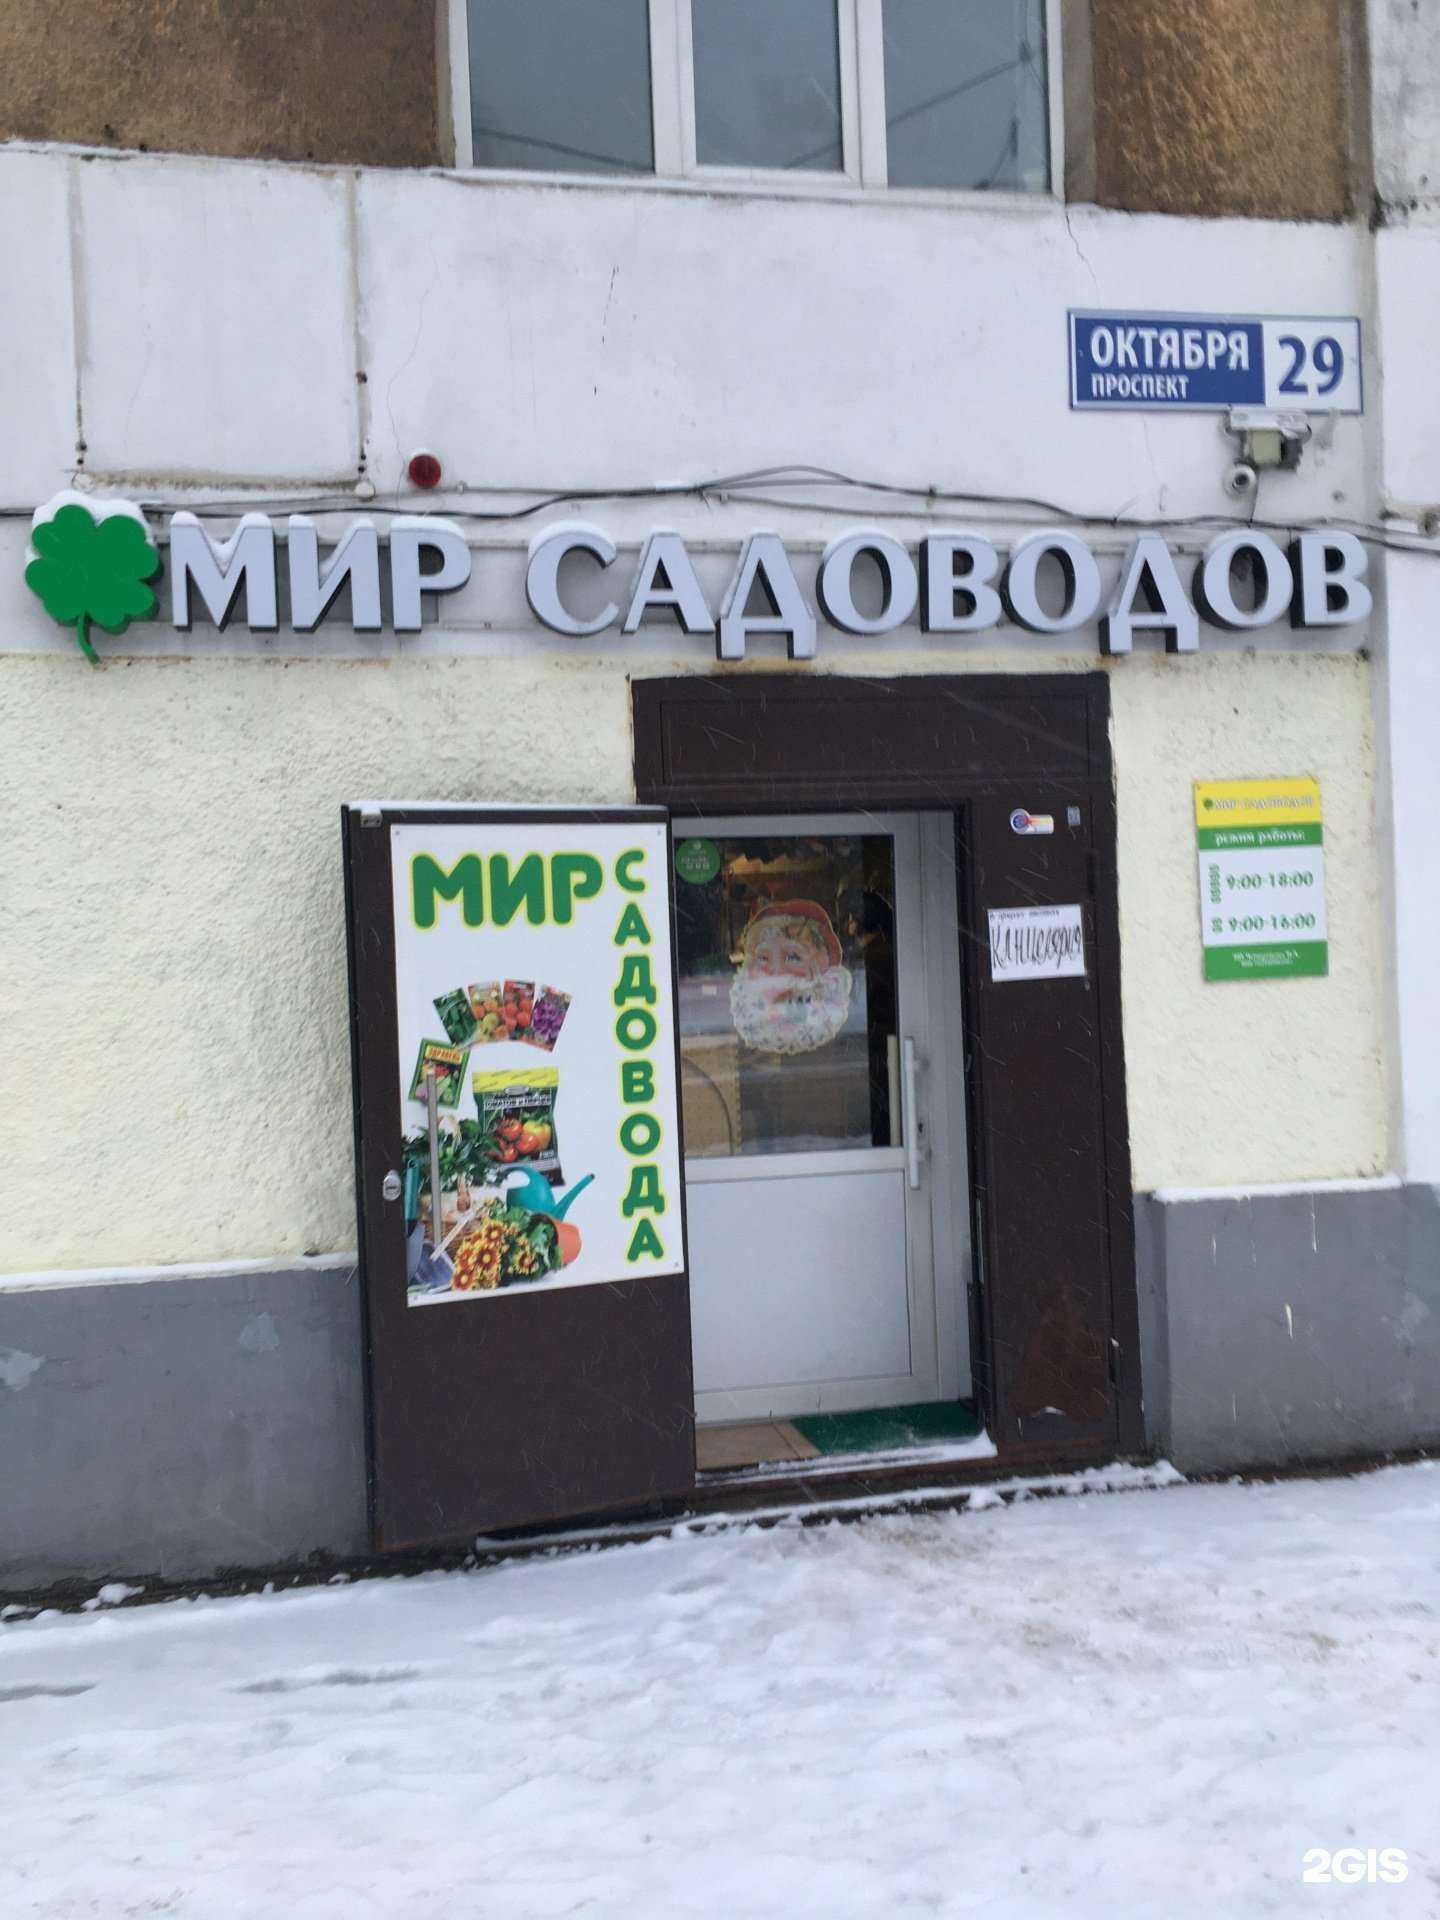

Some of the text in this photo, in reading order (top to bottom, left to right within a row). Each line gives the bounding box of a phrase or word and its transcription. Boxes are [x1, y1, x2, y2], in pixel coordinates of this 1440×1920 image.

[1090, 325, 1251, 371] ОКТЯБРЯ
[1277, 334, 1345, 396] 29
[1090, 373, 1190, 398] ПРОСПЕКТ
[169, 513, 1374, 660] МИР САДОВОДОВ
[410, 850, 604, 928] МИР
[612, 848, 667, 1264] САДОВОДА
